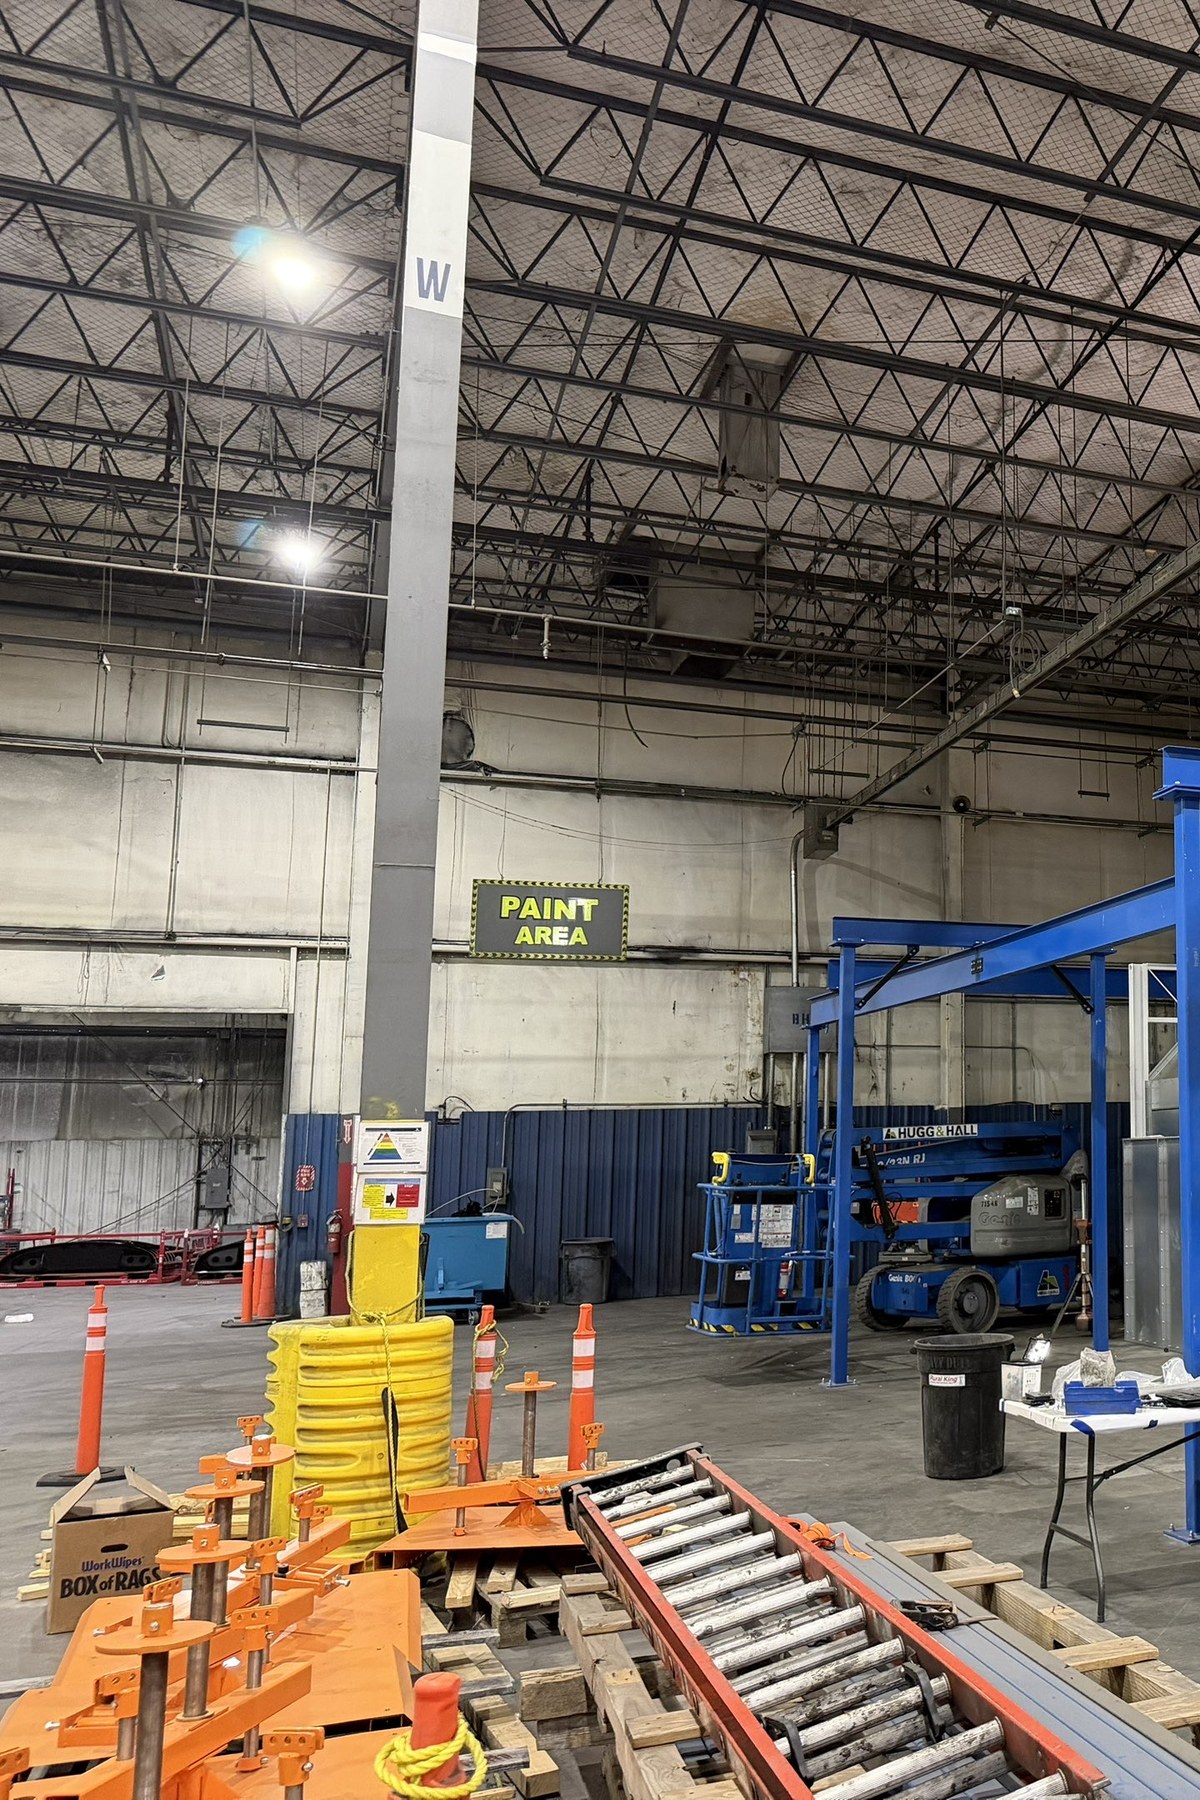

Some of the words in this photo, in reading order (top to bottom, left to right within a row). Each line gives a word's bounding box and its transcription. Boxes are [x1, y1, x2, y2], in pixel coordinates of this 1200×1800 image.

[416, 257, 451, 302] W
[500, 895, 599, 922] PAINT
[514, 925, 588, 946] AREA
[60, 1574, 100, 1599] BOX
[98, 1575, 115, 1591] of
[114, 1566, 162, 1592] RAGS
